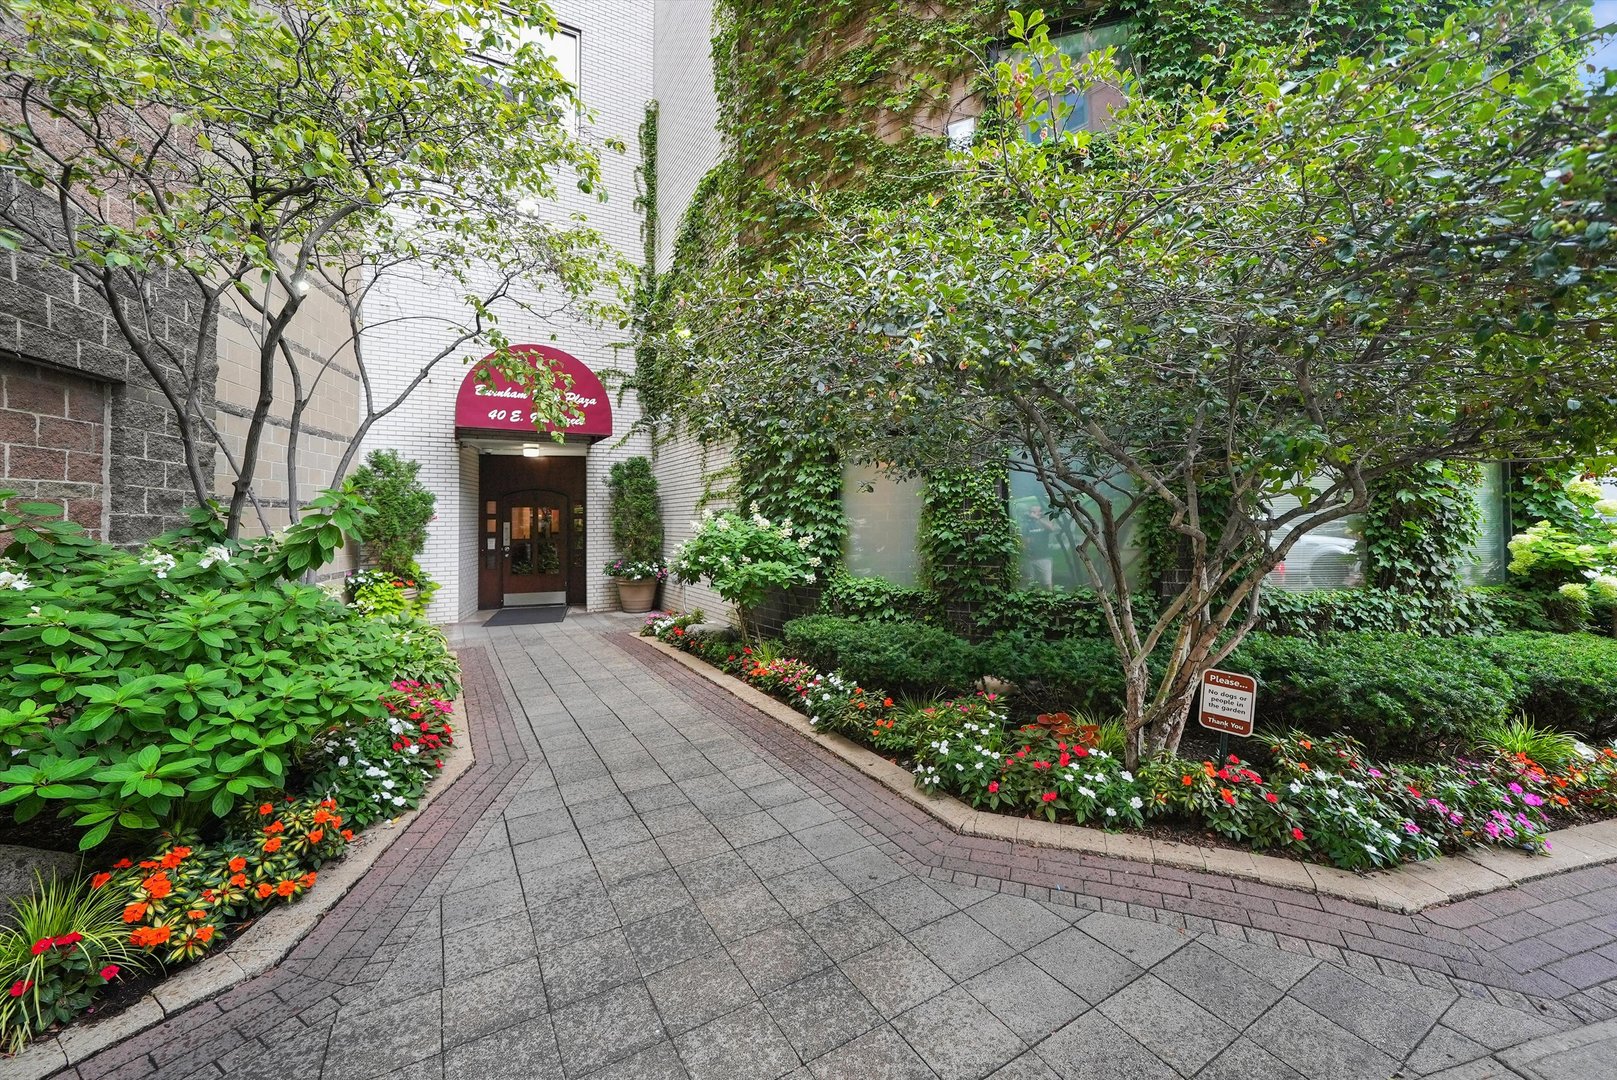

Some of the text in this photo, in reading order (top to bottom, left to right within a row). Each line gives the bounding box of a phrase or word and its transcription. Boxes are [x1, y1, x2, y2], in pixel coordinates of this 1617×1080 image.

[475, 384, 528, 399] Burnham
[565, 392, 597, 408] Plaza
[488, 409, 507, 421] 40
[509, 410, 523, 422] E.
[1220, 691, 1237, 700] dogs
[1210, 697, 1235, 706] people
[1221, 705, 1246, 715] garden
[1207, 716, 1244, 731] Thank You
